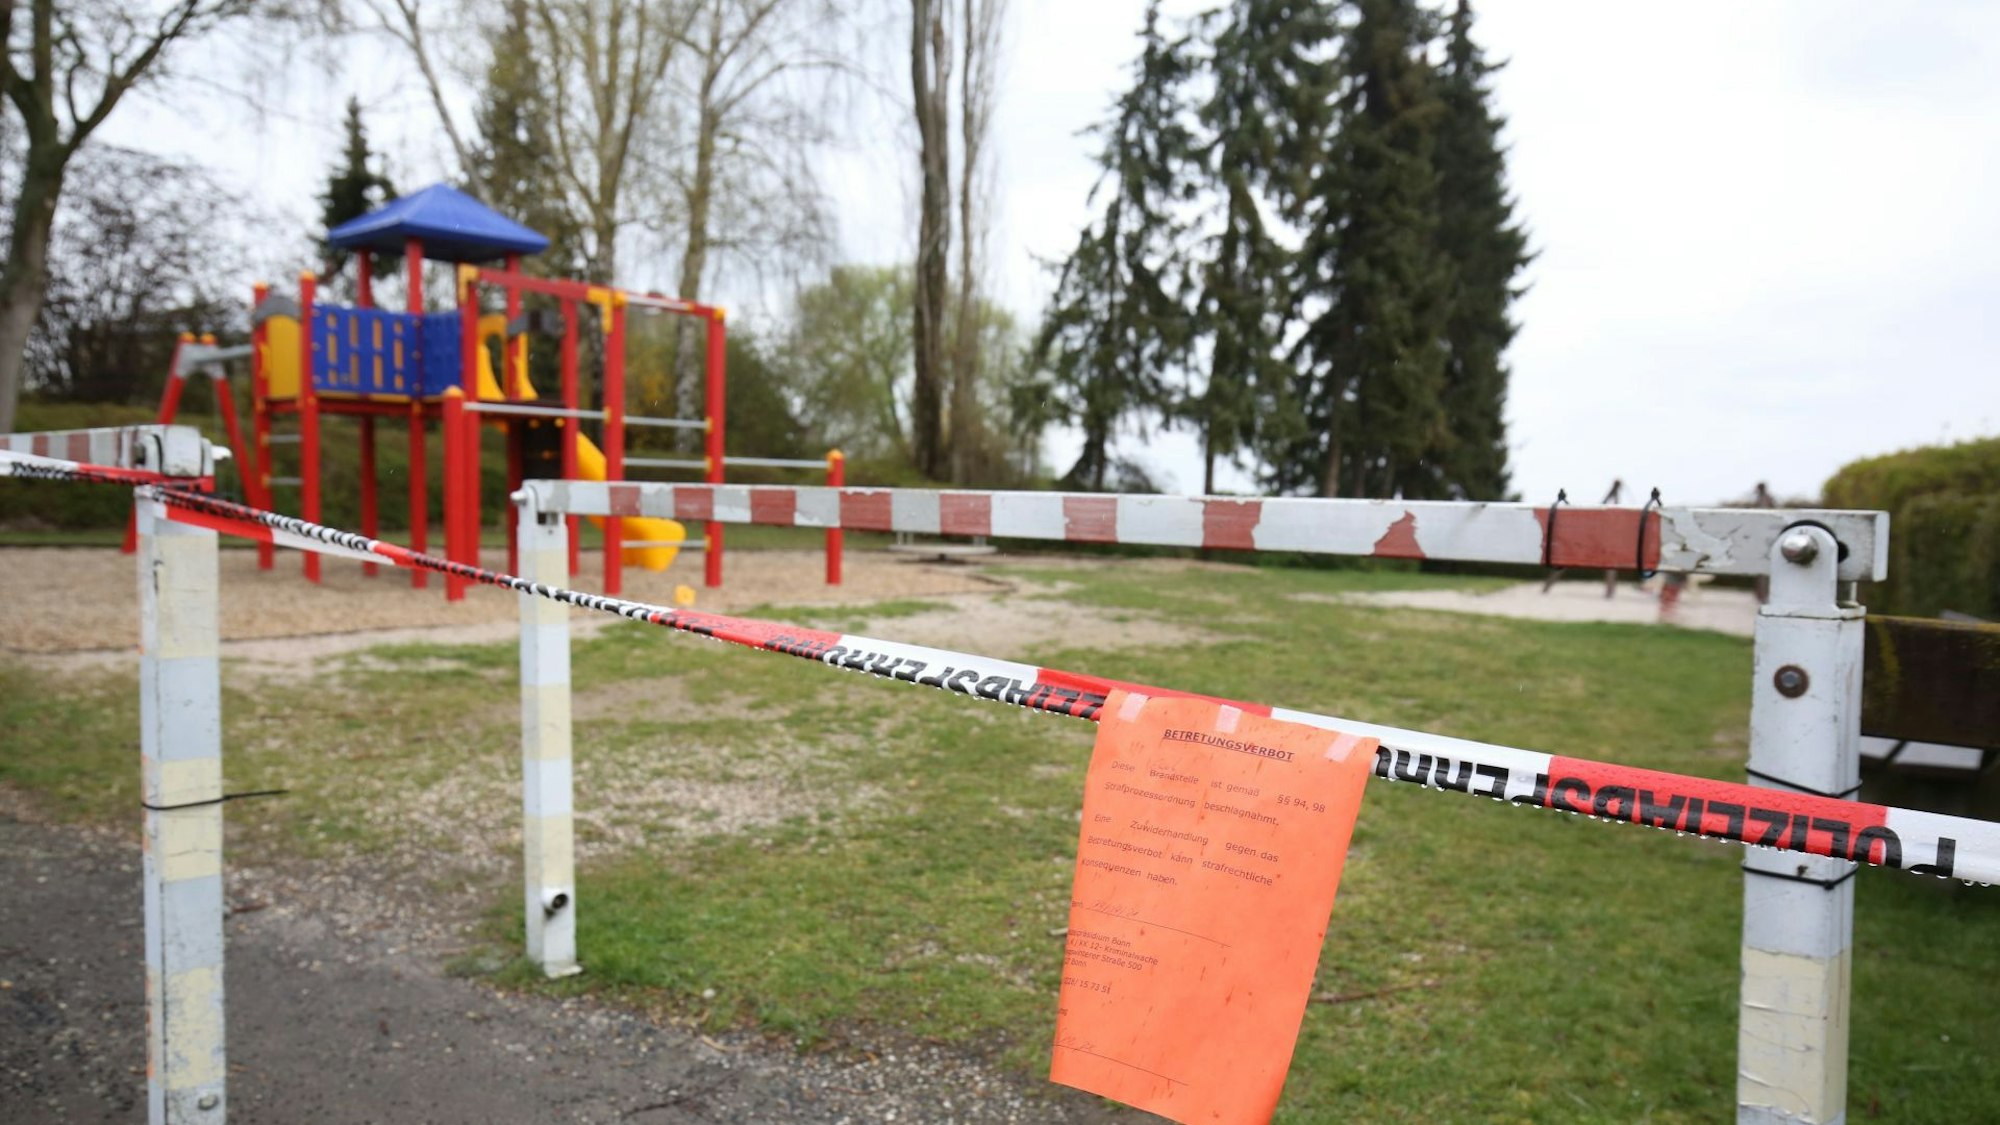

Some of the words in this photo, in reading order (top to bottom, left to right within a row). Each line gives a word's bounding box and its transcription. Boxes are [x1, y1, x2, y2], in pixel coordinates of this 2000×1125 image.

[1163, 728, 1295, 761] BETRETUNGSVERBOT
[1104, 781, 1196, 808] Strafprozessordnung
[1203, 800, 1280, 827] beschlagnahmt.
[1111, 760, 1136, 772] Diese
[1149, 769, 1200, 785] Brandstelle
[1210, 780, 1223, 790] ist
[1293, 797, 1310, 812] 94,
[1312, 802, 1326, 813] 98
[1087, 835, 1163, 858] Betretungsverbot
[1170, 852, 1193, 865] kann
[1202, 860, 1273, 886] strafrechtliche
[1094, 813, 1112, 824] Eine
[1129, 820, 1209, 846] Zuwiderhandlung
[1225, 842, 1257, 857] gegen
[1260, 851, 1279, 863] das
[1146, 872, 1178, 887] haben.
[1101, 955, 1126, 968] Straße
